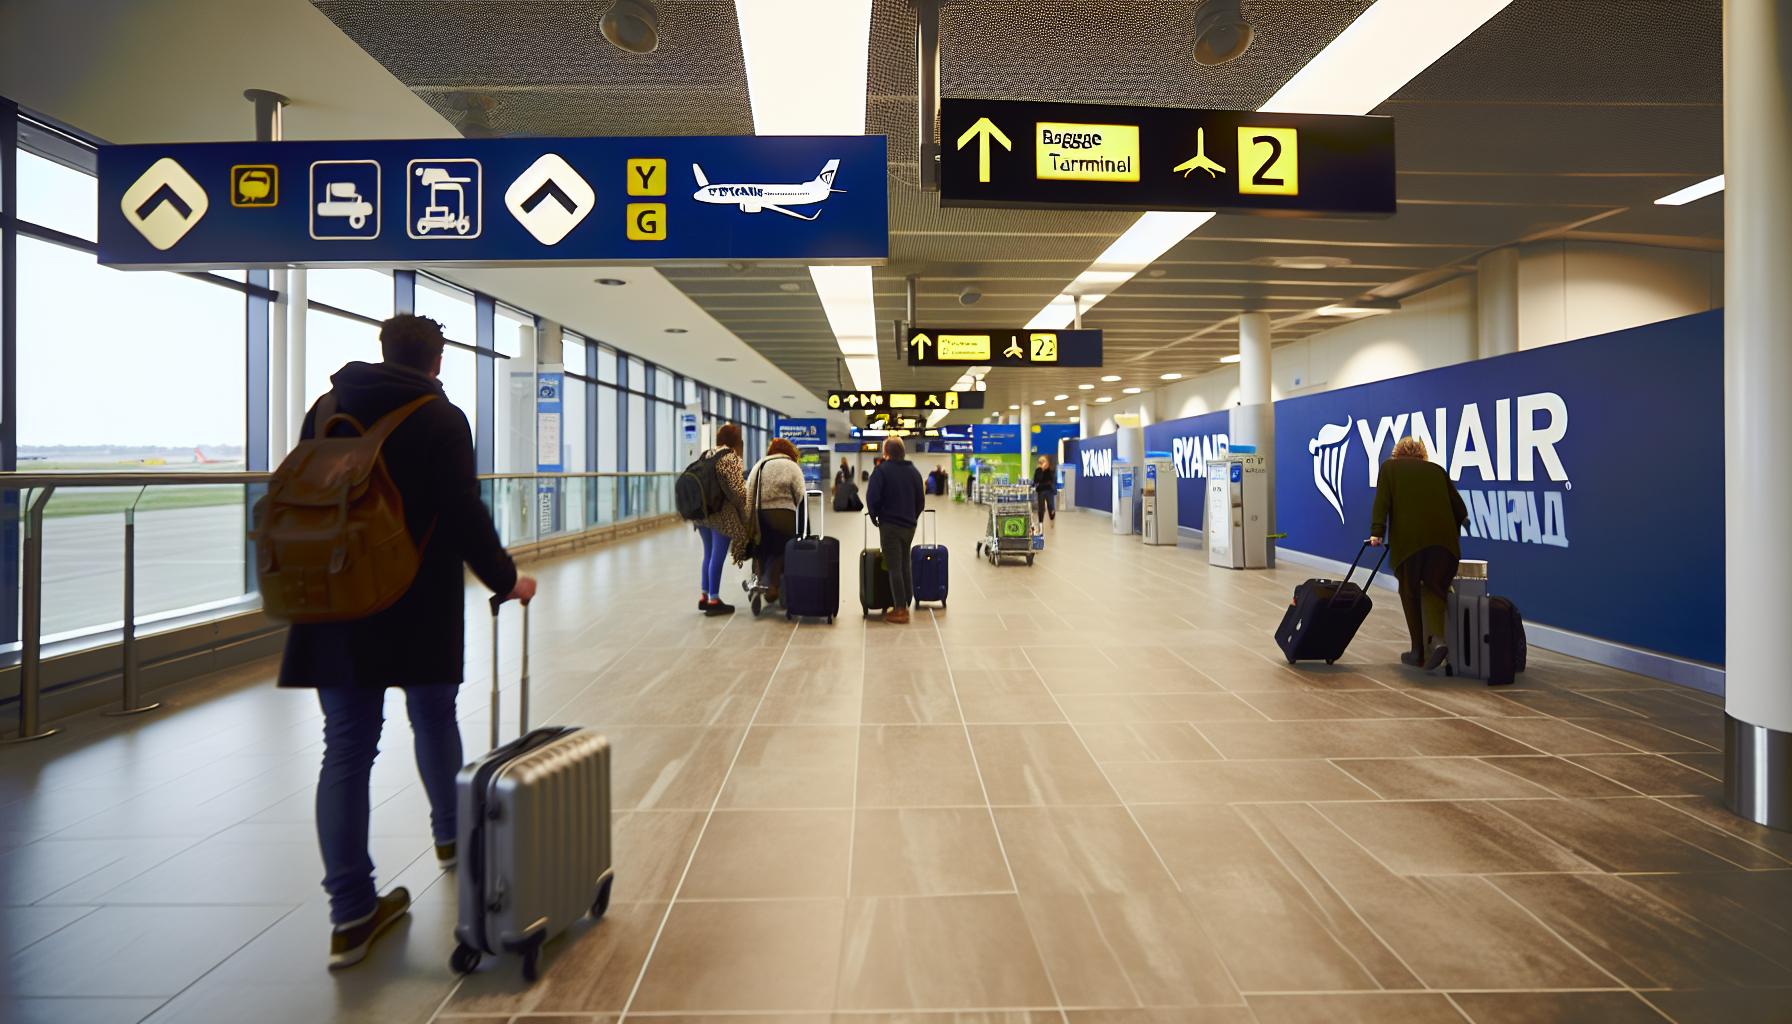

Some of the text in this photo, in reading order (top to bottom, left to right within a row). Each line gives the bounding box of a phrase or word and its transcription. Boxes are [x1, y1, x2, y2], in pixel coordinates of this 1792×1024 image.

[1252, 135, 1285, 187] 2
[635, 165, 657, 190] Y
[636, 209, 657, 234] G
